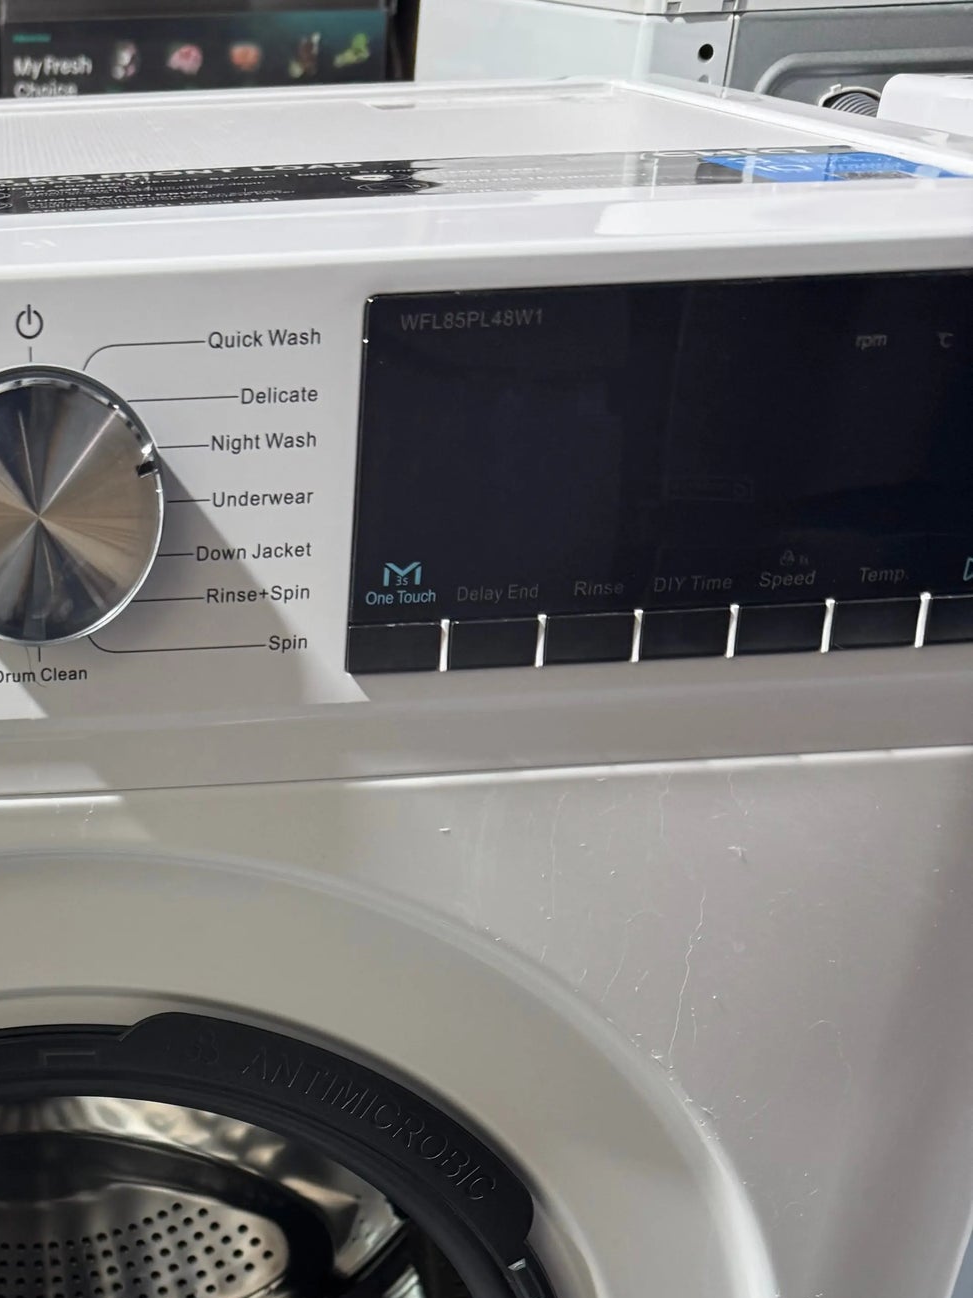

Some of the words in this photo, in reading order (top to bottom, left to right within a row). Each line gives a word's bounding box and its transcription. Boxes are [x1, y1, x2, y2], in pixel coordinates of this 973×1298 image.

[43, 53, 93, 75] Fresh
[250, 162, 362, 172] LOAD
[400, 309, 543, 332] WFL85PL48W1
[208, 331, 263, 349] Quick
[268, 328, 321, 346] Wash
[241, 387, 318, 404] Delicate
[211, 434, 260, 455] Night
[265, 431, 317, 449] Wash
[213, 491, 314, 508] Underwear
[196, 545, 247, 562] Down
[252, 542, 312, 559] Jacket
[573, 580, 625, 597] Rinse
[653, 576, 685, 593] DIY
[690, 574, 733, 591] Time
[759, 569, 816, 590] Speed
[206, 584, 311, 604] Rinse+Spin
[365, 591, 394, 606] One
[397, 588, 437, 605] Touch
[456, 586, 503, 604] Delay
[508, 583, 539, 599] End
[268, 634, 308, 653] Spin
[40, 667, 88, 682] Clean
[241, 1044, 497, 1201] ANTIMICROBIC
